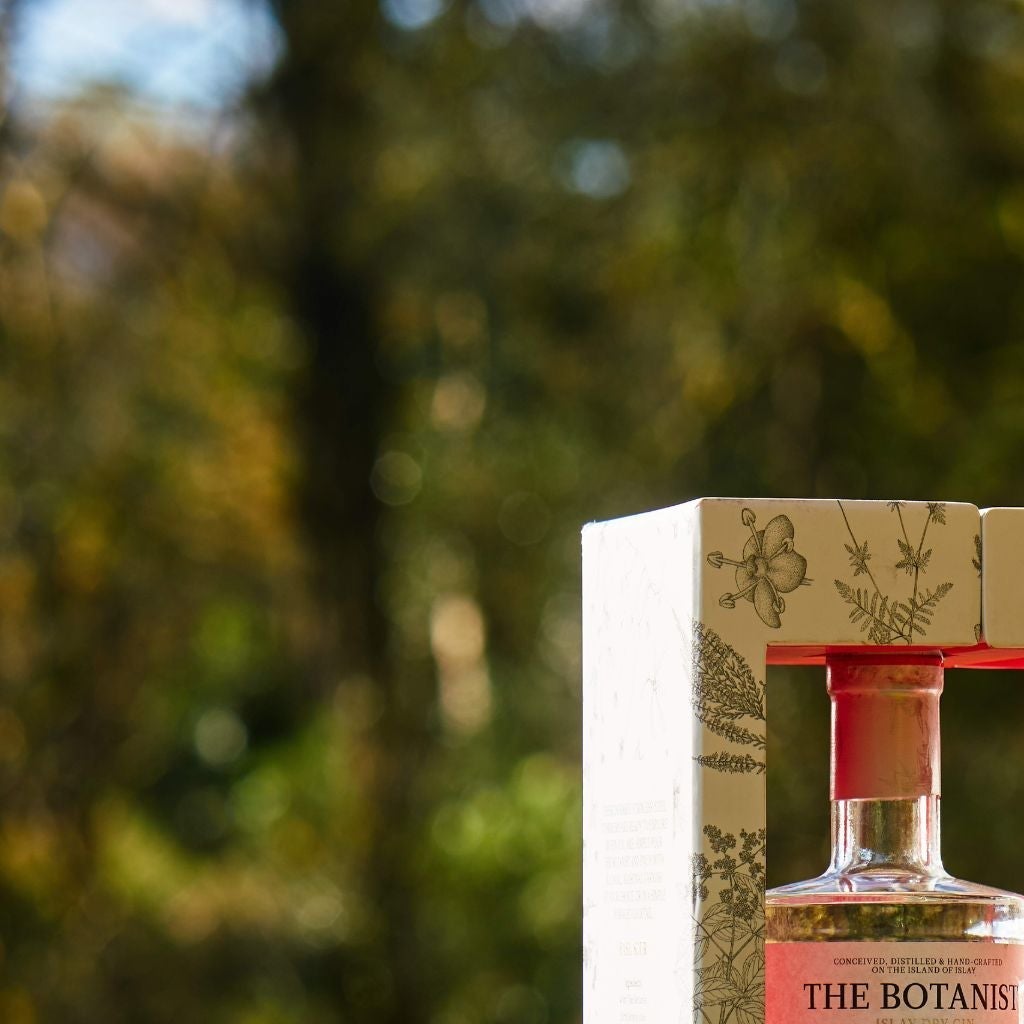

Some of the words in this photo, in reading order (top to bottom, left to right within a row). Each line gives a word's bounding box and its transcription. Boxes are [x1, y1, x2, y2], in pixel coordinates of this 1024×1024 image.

[833, 957, 888, 967] CONCEIVED,
[890, 957, 937, 966] DISTILLED
[938, 957, 945, 966] &
[947, 958, 1003, 966] HAND-CRAFTED
[871, 966, 885, 974] ON
[887, 966, 906, 974] THE
[907, 966, 940, 974] ISLAND
[942, 966, 954, 974] OF
[955, 966, 976, 975] ISLAY
[803, 982, 870, 1010] THE
[880, 982, 1019, 1011] BOTANIST
